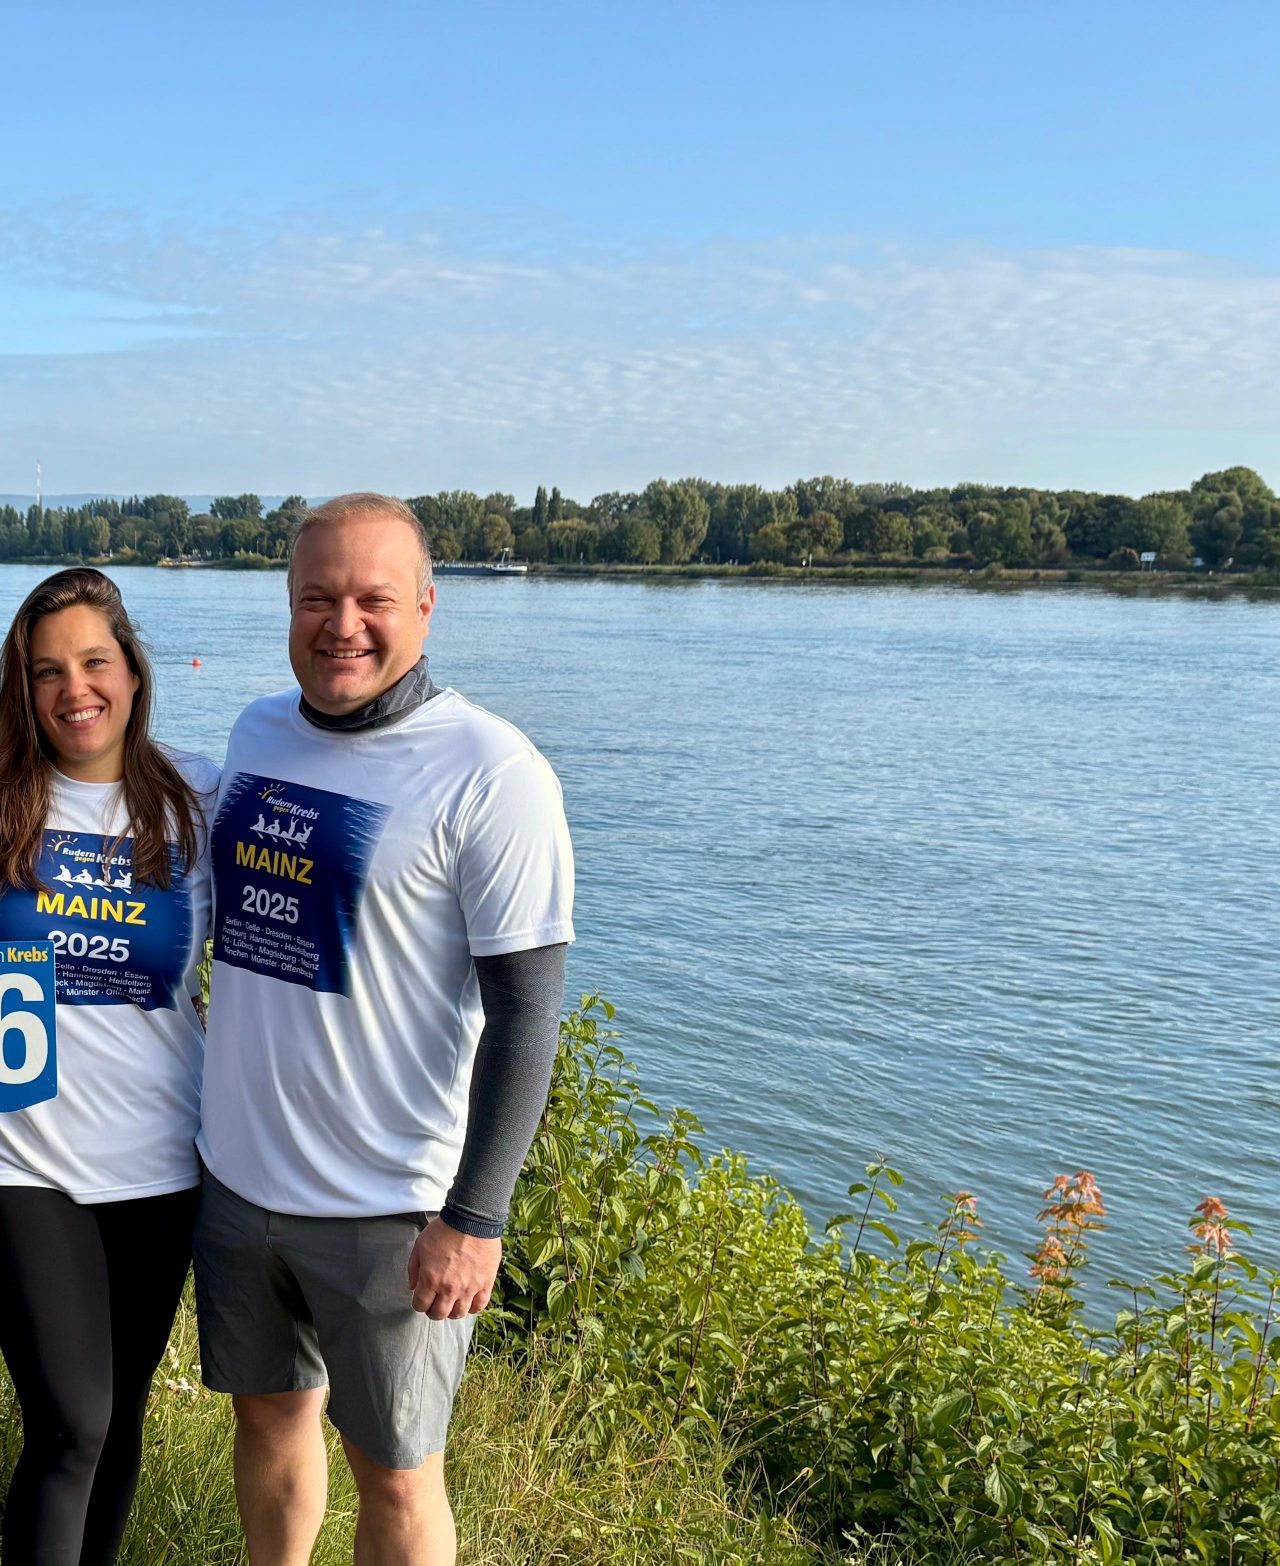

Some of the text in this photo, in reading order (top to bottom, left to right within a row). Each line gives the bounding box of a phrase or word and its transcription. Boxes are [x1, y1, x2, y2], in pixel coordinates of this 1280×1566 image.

[289, 804, 320, 820] Krebs
[62, 847, 96, 858] Rudern
[96, 853, 132, 866] Krebs
[235, 841, 314, 885] MAINZ
[36, 891, 147, 926] MAINZ
[241, 885, 299, 924] 2025
[245, 921, 261, 933] Celle
[265, 927, 292, 941] Dresden
[7, 946, 48, 963] Krebs
[47, 930, 130, 963] 2025
[82, 966, 117, 976] Dresden
[124, 971, 149, 980] Essen
[109, 977, 152, 988] Heidelberg
[128, 987, 151, 995] Mainz
[66, 988, 100, 996] Münster
